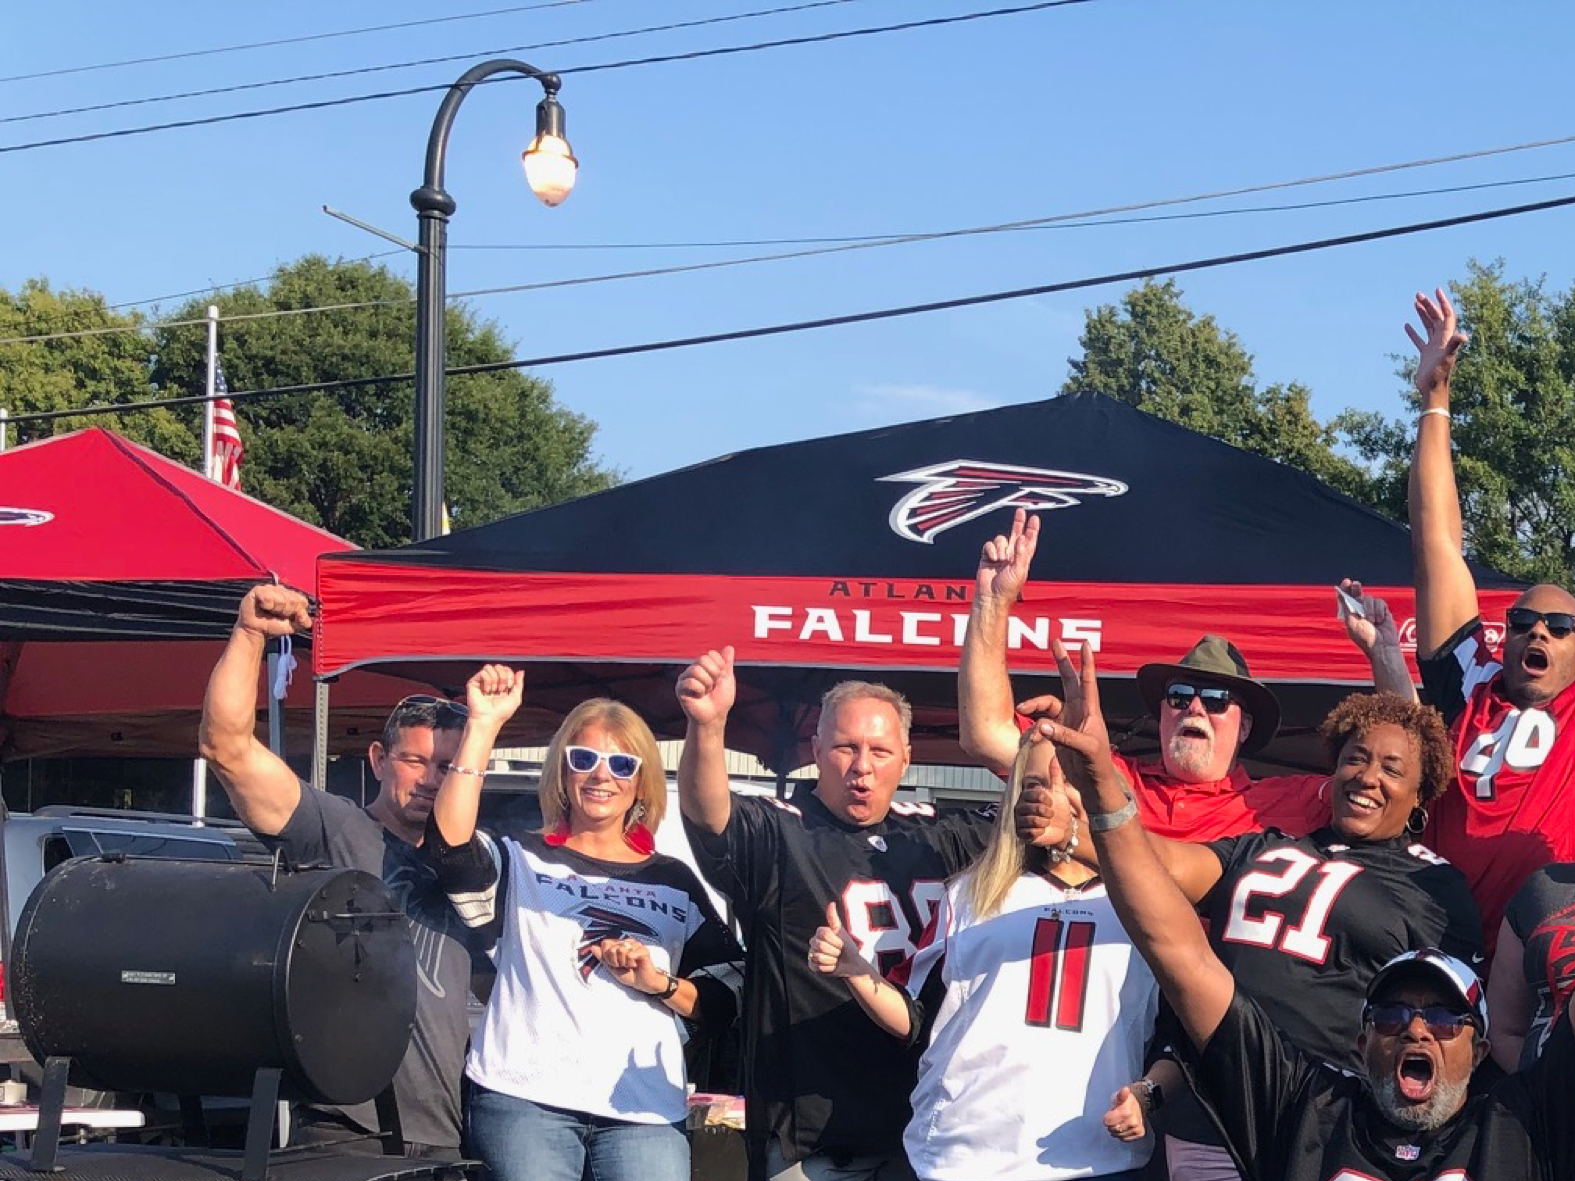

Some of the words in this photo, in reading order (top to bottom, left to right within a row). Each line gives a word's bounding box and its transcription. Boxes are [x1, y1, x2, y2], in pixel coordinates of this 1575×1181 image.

[829, 580, 1024, 603] ATLAN
[535, 873, 687, 924] FALCONS
[566, 874, 657, 898] AANTA
[1222, 847, 1365, 965] 21
[1025, 917, 1096, 1033] 11
